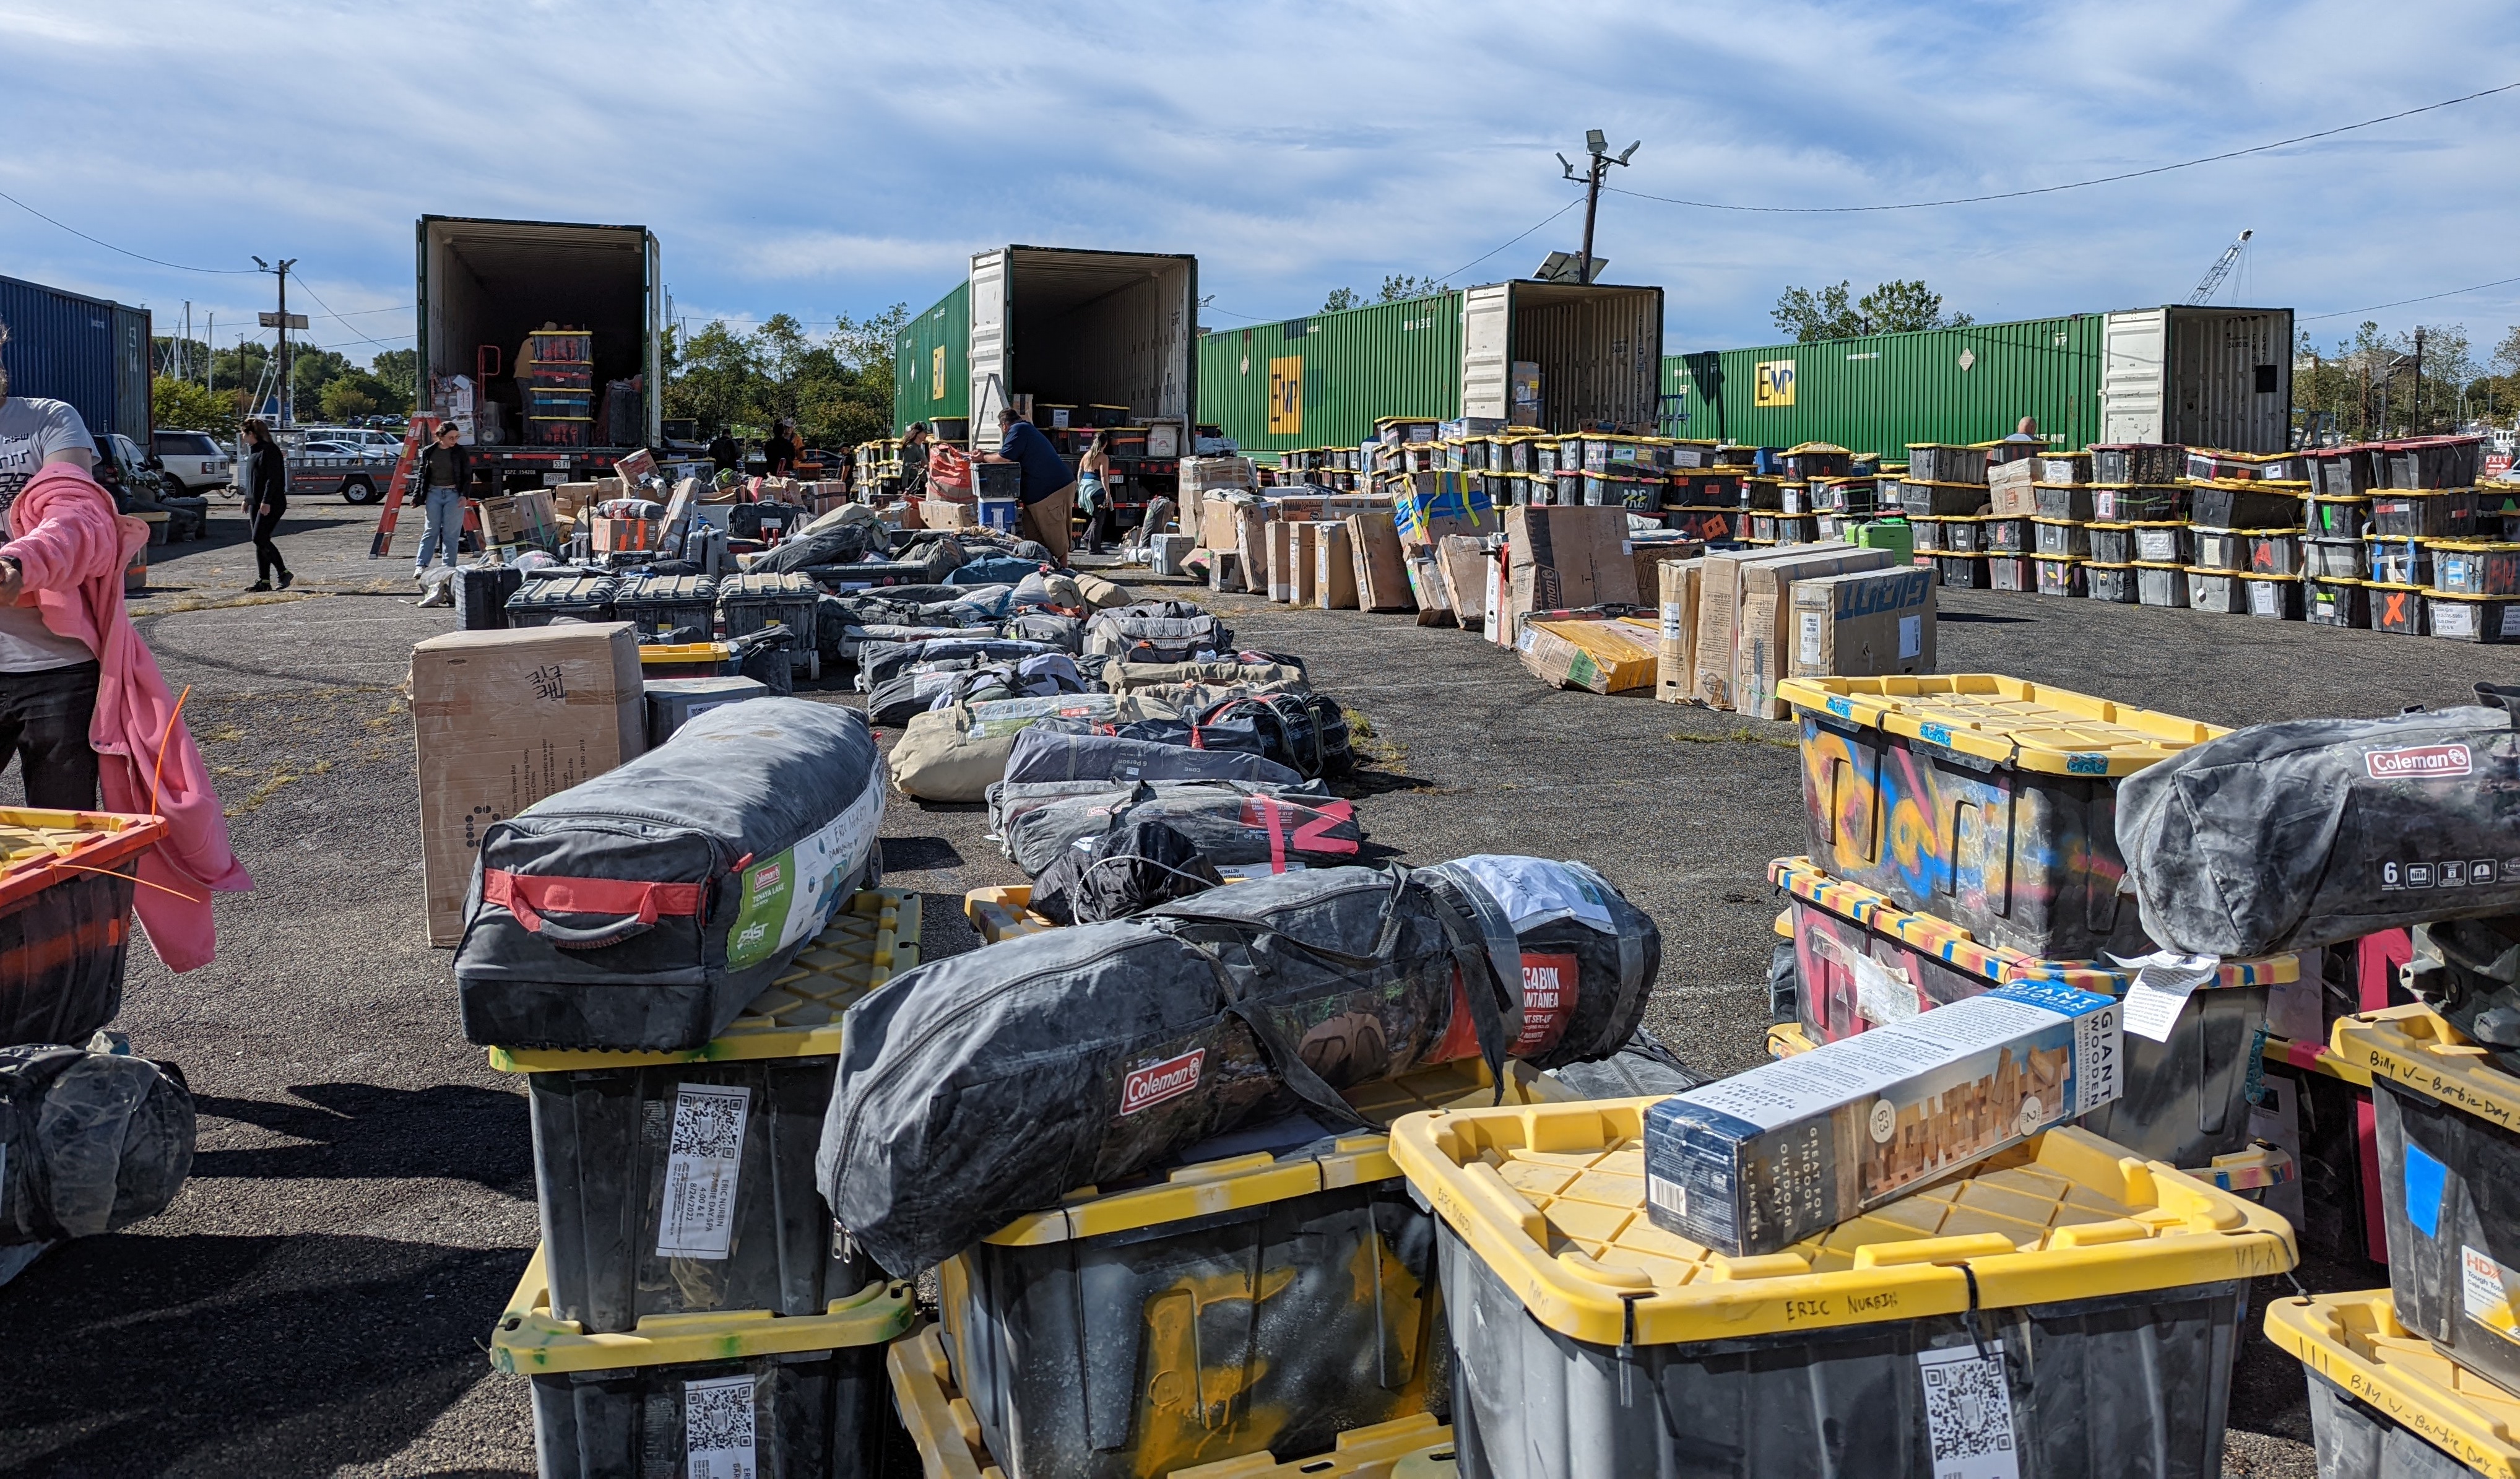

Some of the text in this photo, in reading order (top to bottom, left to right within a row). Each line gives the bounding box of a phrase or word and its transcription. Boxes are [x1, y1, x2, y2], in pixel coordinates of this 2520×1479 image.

[1759, 365, 1793, 401] EMP
[2050, 433, 2066, 443] ONLY
[563, 460, 569, 468] FT
[2253, 542, 2273, 567] A
[1836, 571, 1931, 620] GIANT
[525, 666, 563, 685] EYE
[533, 678, 566, 701] THE
[2373, 753, 2449, 771] Coleman
[756, 869, 776, 887] Coleman
[2384, 861, 2398, 883] 6
[752, 883, 786, 904] TENAYA LAKE
[1522, 968, 1560, 990] CABIN
[1523, 990, 1559, 1008] ANTÁNEA
[1999, 987, 2085, 1010] WOODEN
[2007, 983, 2098, 1005] GIANT
[1533, 1014, 1552, 1023] SET-UP
[2090, 1014, 2100, 1106] WOODEN
[2101, 1011, 2113, 1099] GIANT
[1128, 1067, 1189, 1103] Coleman
[1731, 1082, 1798, 1105] INCLUDES:
[2370, 1050, 2396, 1078] Billy
[2485, 1101, 2509, 1126] Day
[1711, 1095, 1744, 1108] OVER
[1725, 1091, 1770, 1106] BRICKS
[1734, 1087, 1795, 1110] WOODEN
[1877, 1109, 1889, 1134] 63
[2026, 1109, 2037, 1124] 2
[1801, 1143, 1812, 1212] INDOOR
[1810, 1127, 1822, 1220] GREAT FOR
[698, 1187, 707, 1204] 4:00
[1772, 1165, 1783, 1214] PLAY!
[1780, 1143, 1793, 1228] OUTDOOR
[686, 1182, 697, 1221] 8/24/2022
[708, 1201, 716, 1217] DAY
[717, 1179, 729, 1227] ERIC NURBIN
[1749, 1183, 1759, 1241] PLAYERS
[705, 1218, 714, 1232] SPA
[2466, 1252, 2504, 1285] HDX
[2467, 1270, 2488, 1286] Tough
[2467, 1278, 2479, 1291] Caja
[1786, 1300, 1830, 1324] ERIC
[2350, 1374, 2381, 1403] Billy
[2389, 1397, 2402, 1413] W
[2415, 1414, 2462, 1455] Barbie
[2467, 1446, 2492, 1470] Day
[733, 1463, 741, 1479] BAR
